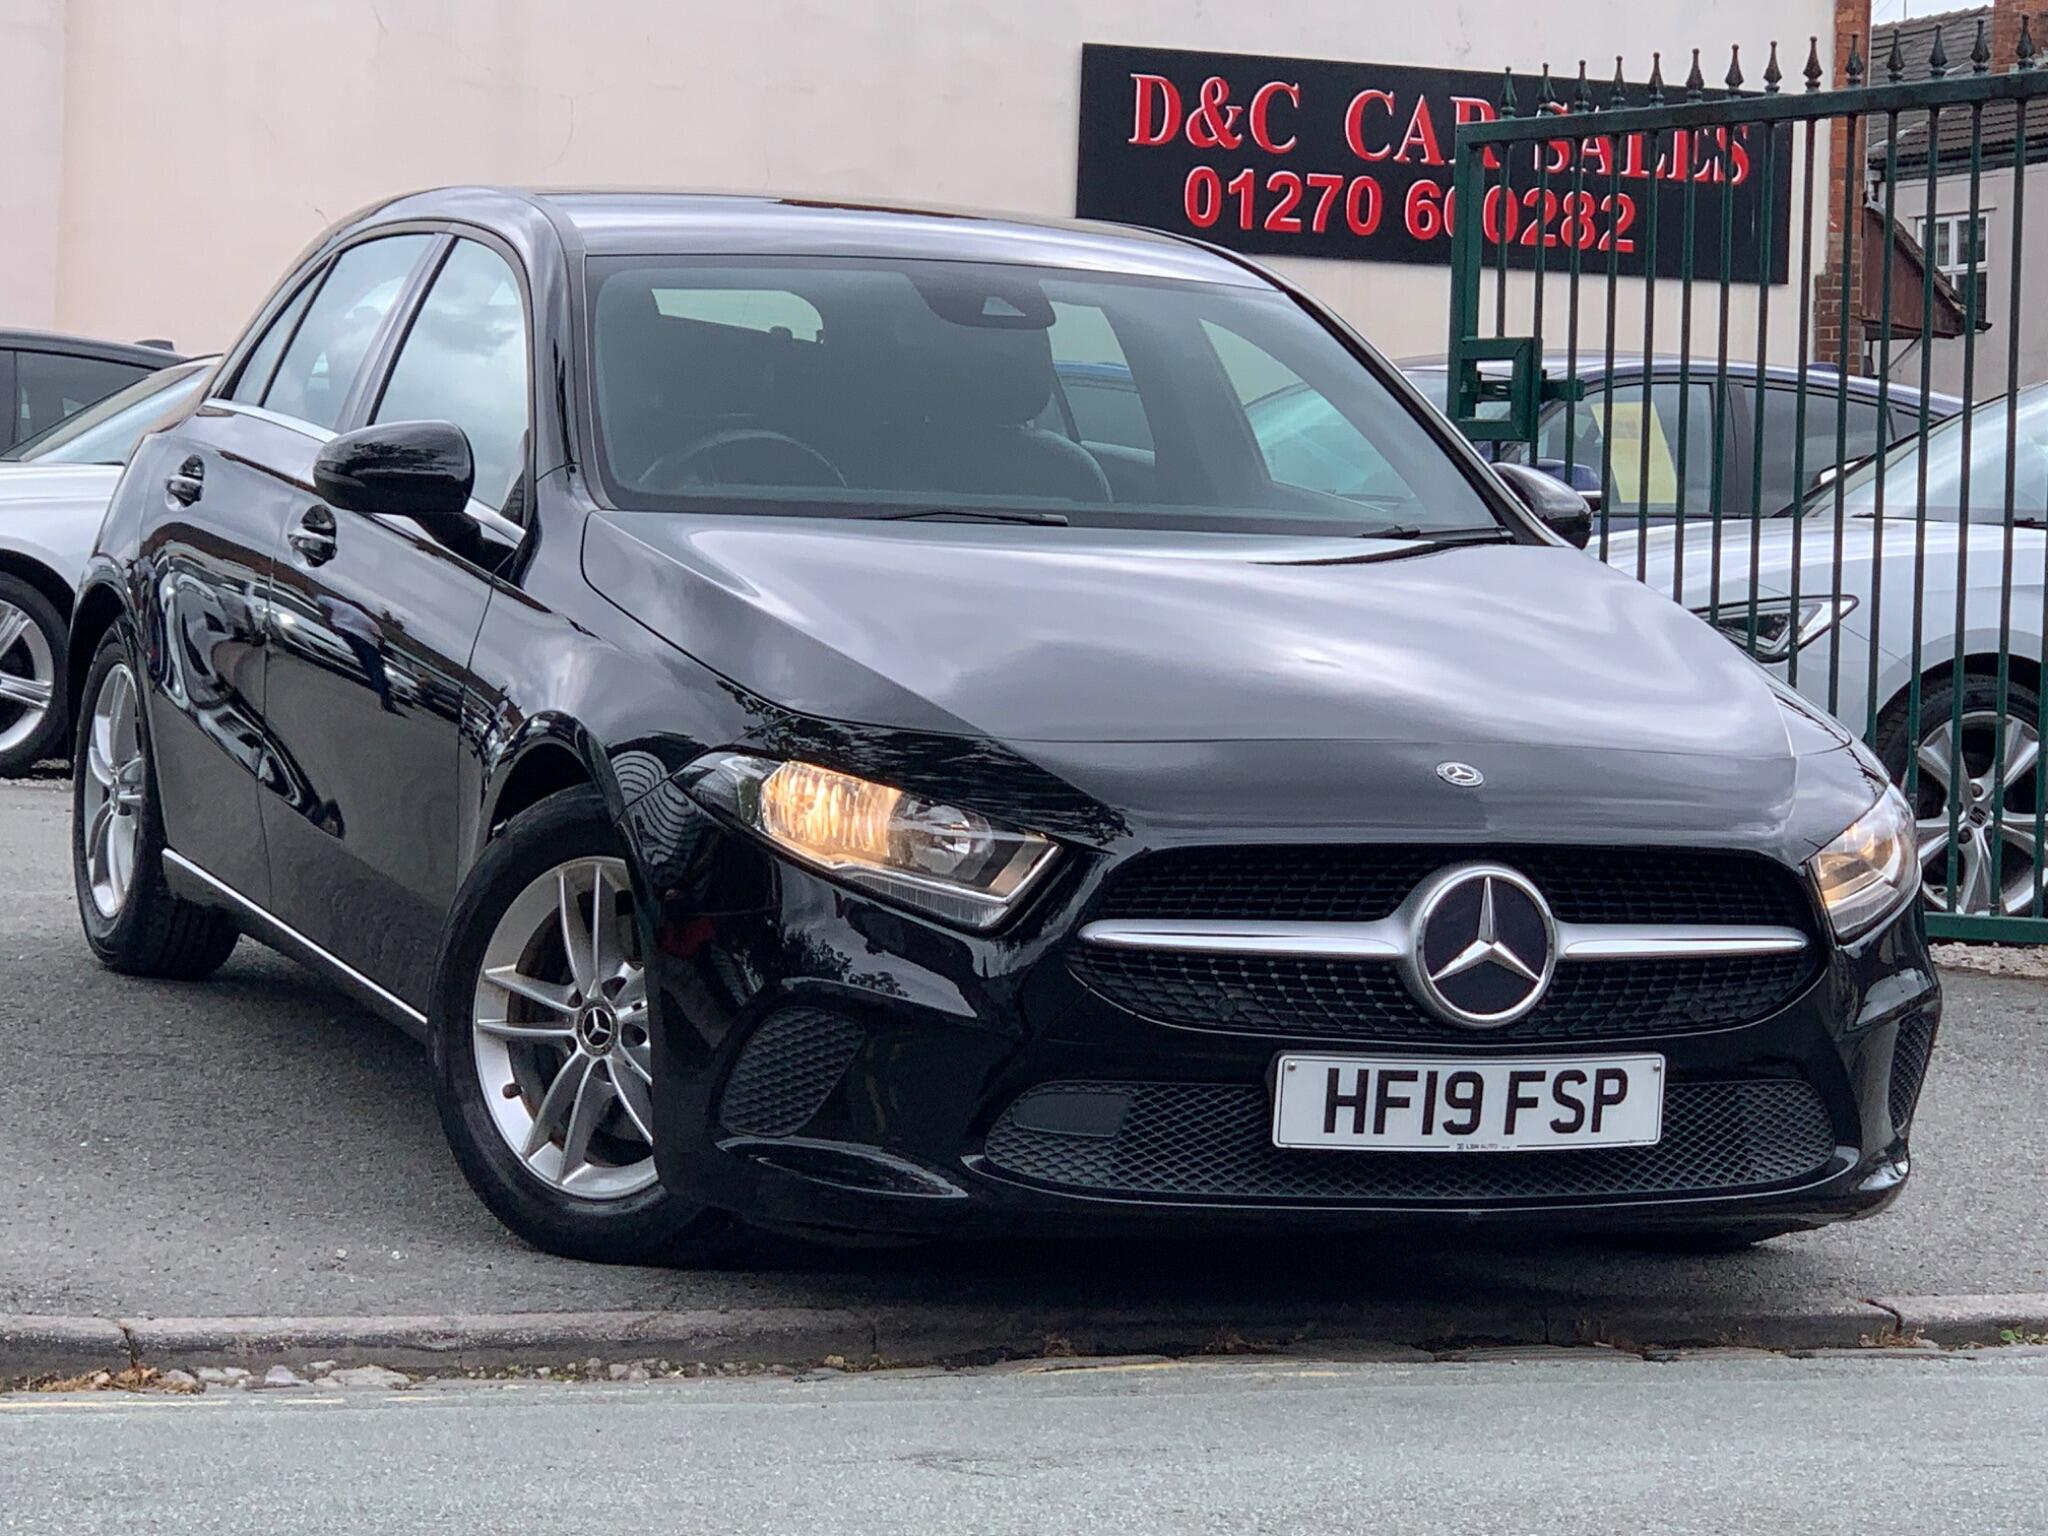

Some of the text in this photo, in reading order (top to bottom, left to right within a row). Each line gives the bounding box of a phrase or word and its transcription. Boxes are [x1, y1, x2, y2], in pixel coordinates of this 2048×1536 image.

[1129, 73, 1302, 155] D&C
[1184, 166, 1384, 237] 01270
[1323, 1067, 1629, 1136] HF19 FSP
